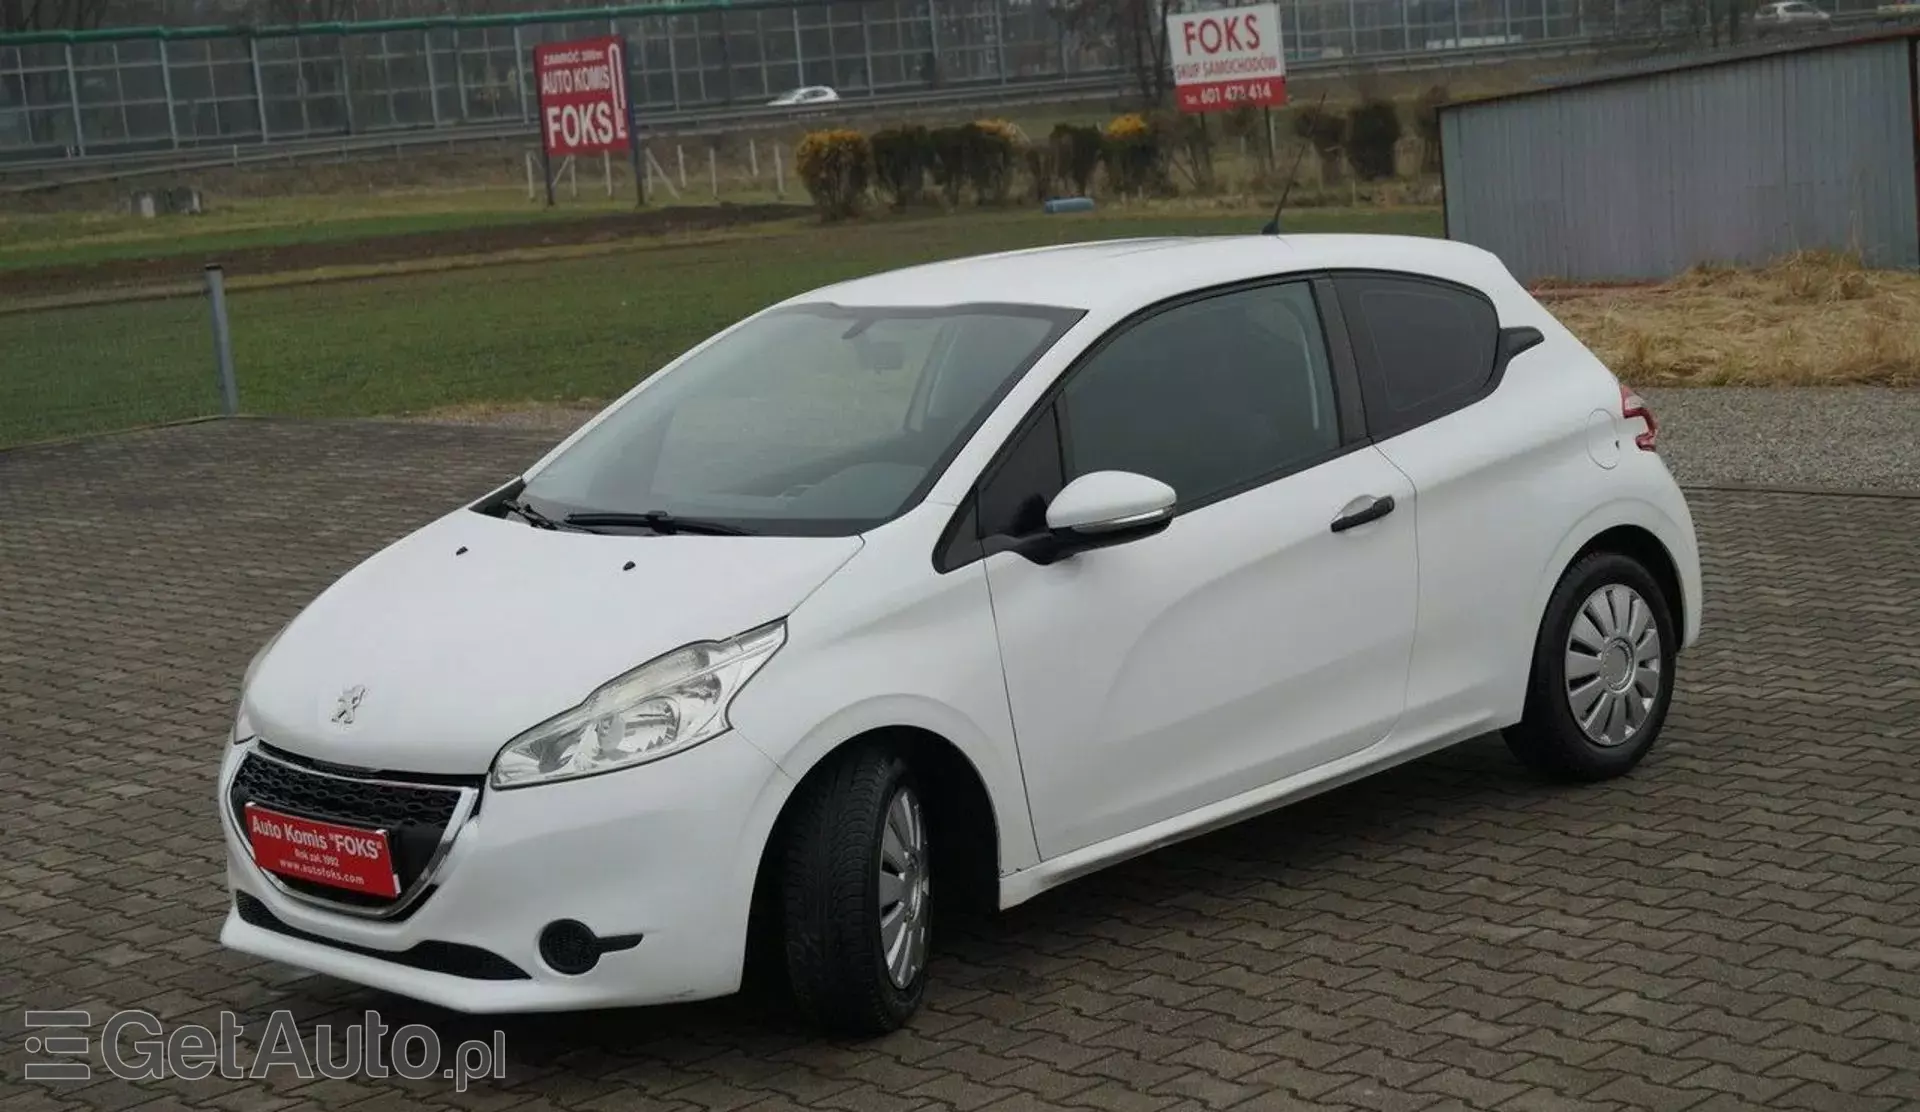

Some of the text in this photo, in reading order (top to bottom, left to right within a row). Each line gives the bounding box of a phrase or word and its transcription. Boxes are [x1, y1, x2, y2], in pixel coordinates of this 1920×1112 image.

[1183, 13, 1260, 56] FOKS
[542, 65, 610, 94] AUTO KOMIS
[546, 101, 614, 148] FOKS
[252, 815, 282, 840] Auto
[284, 823, 329, 850] Komis
